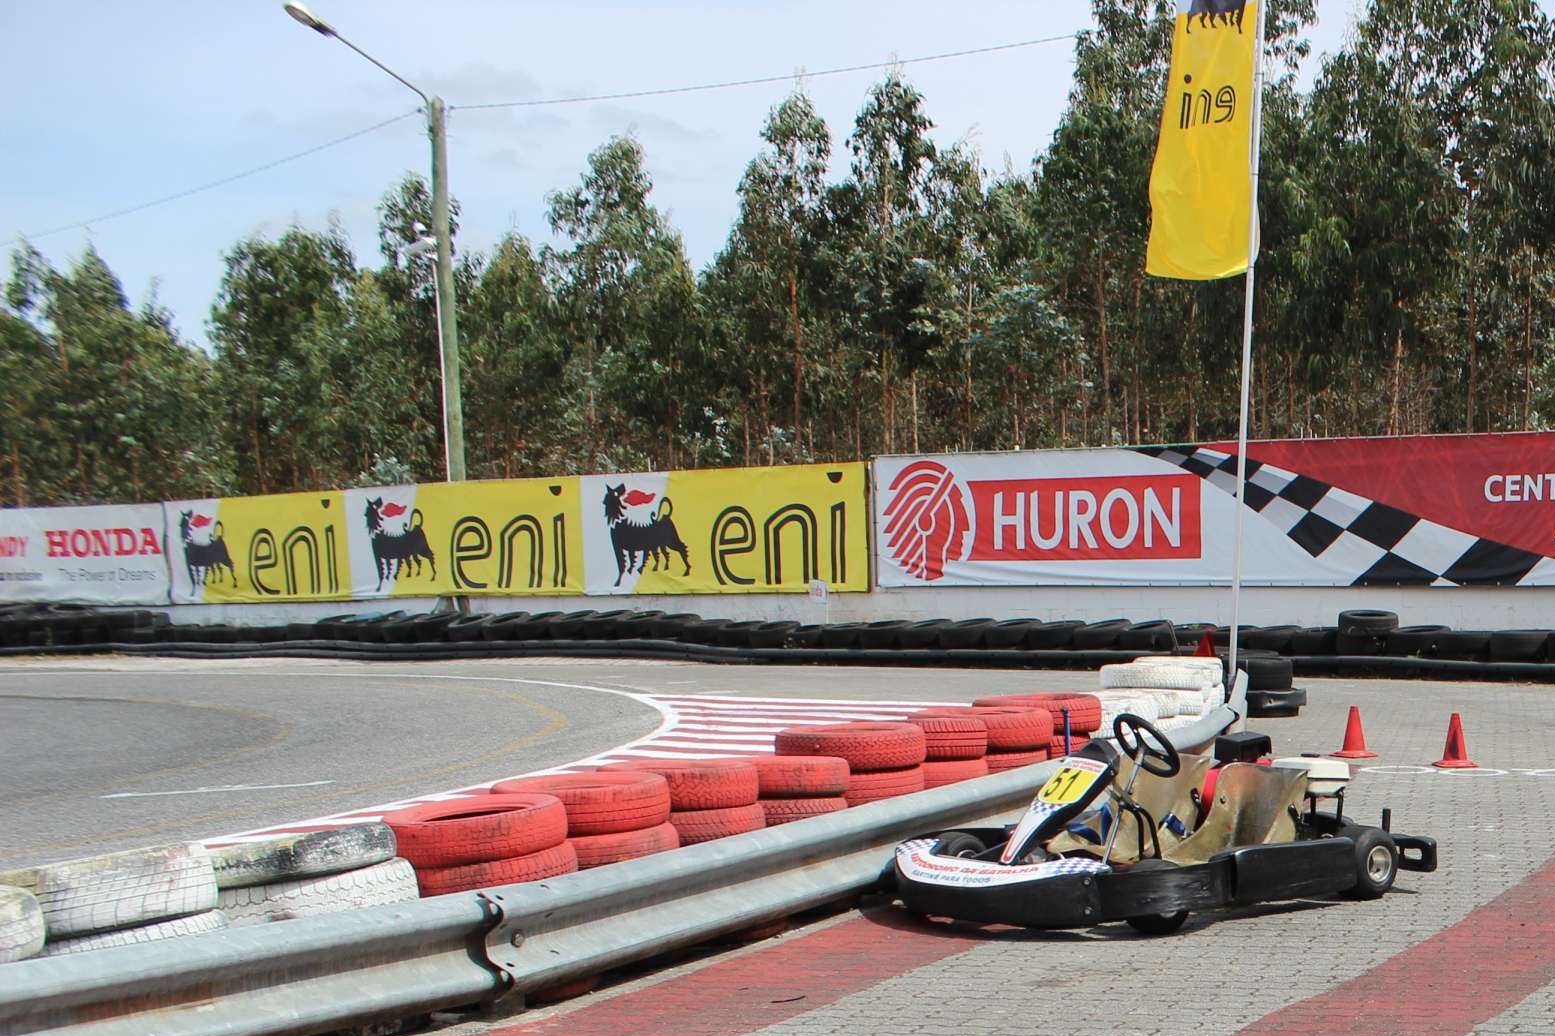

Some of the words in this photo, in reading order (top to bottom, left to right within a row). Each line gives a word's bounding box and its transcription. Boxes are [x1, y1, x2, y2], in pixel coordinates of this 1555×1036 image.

[44, 527, 162, 558] HONDA
[248, 498, 338, 595] eni
[451, 485, 567, 589] eni
[710, 471, 846, 585] eni
[993, 487, 1181, 550] HURON
[1044, 767, 1082, 801] 51
